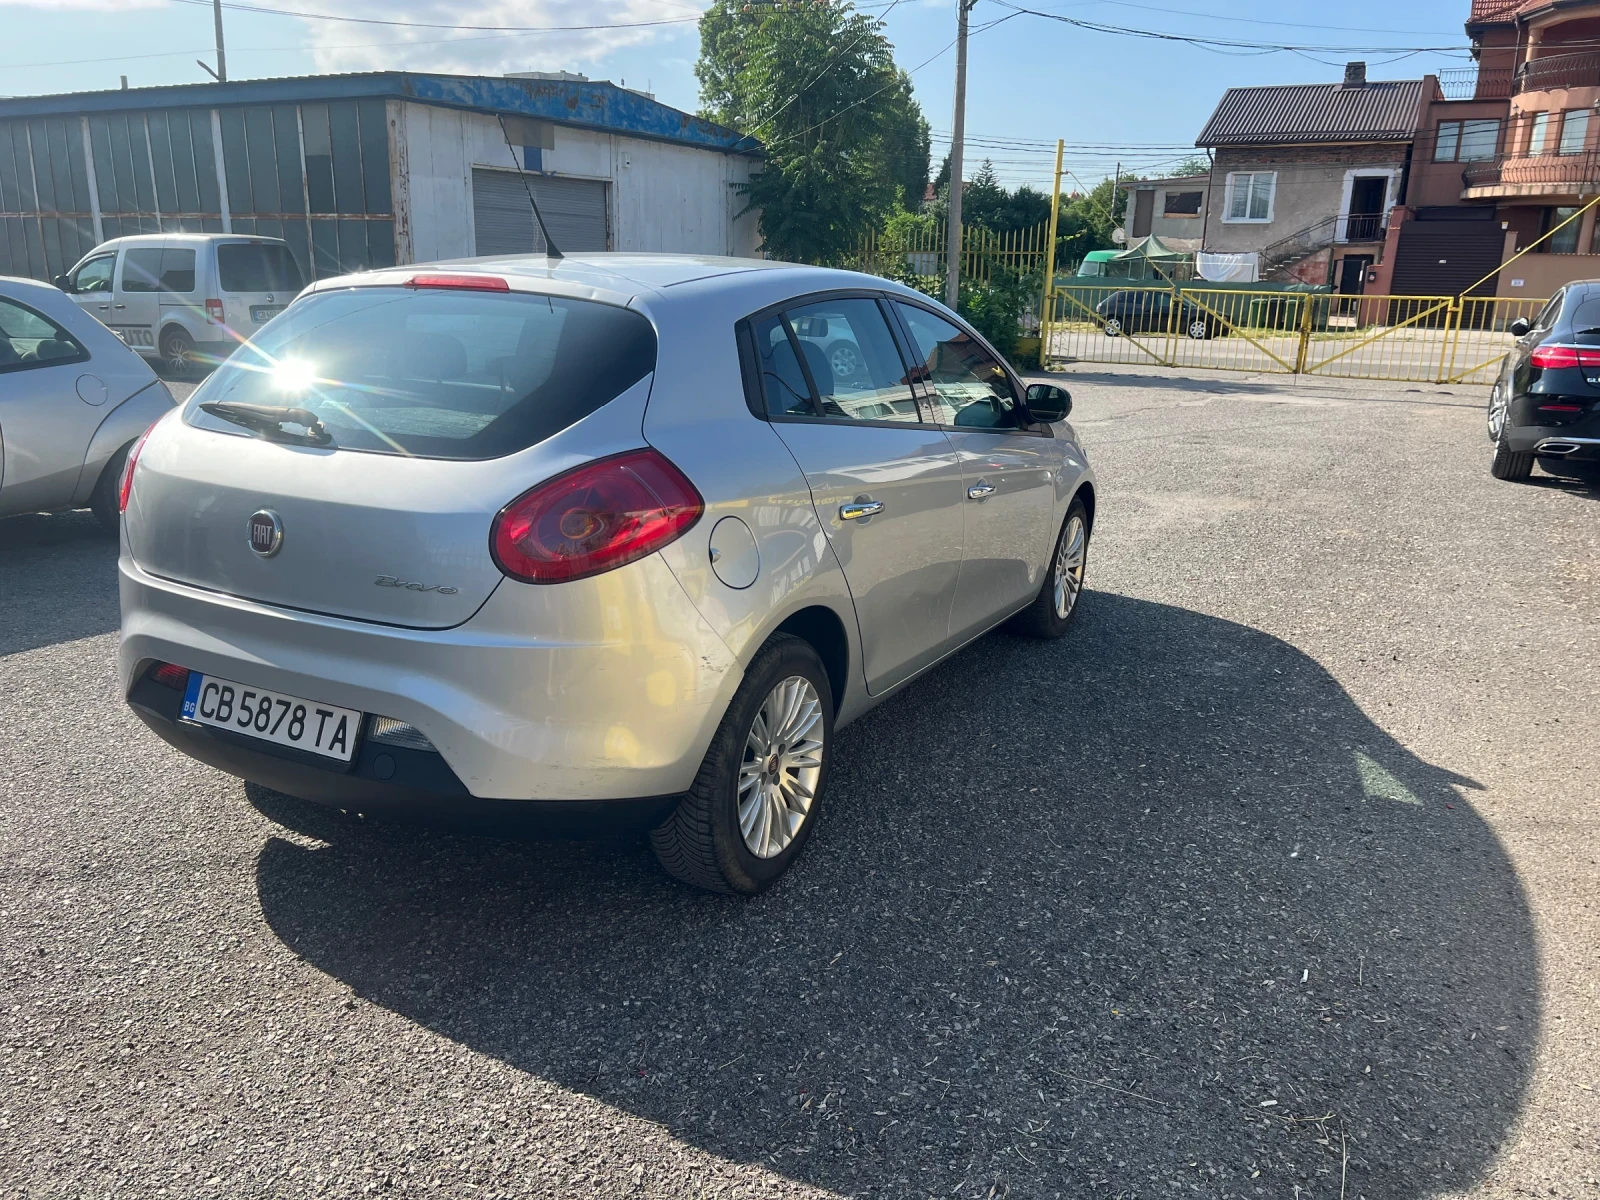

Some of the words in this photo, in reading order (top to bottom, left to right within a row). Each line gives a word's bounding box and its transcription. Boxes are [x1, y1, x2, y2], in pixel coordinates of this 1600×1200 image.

[115, 329, 154, 346] UTO
[253, 523, 272, 545] FIAT
[374, 574, 458, 594] Bravo
[184, 700, 196, 713] BG
[200, 682, 235, 722] CB
[237, 691, 307, 741] 5878
[315, 708, 348, 754] TA
